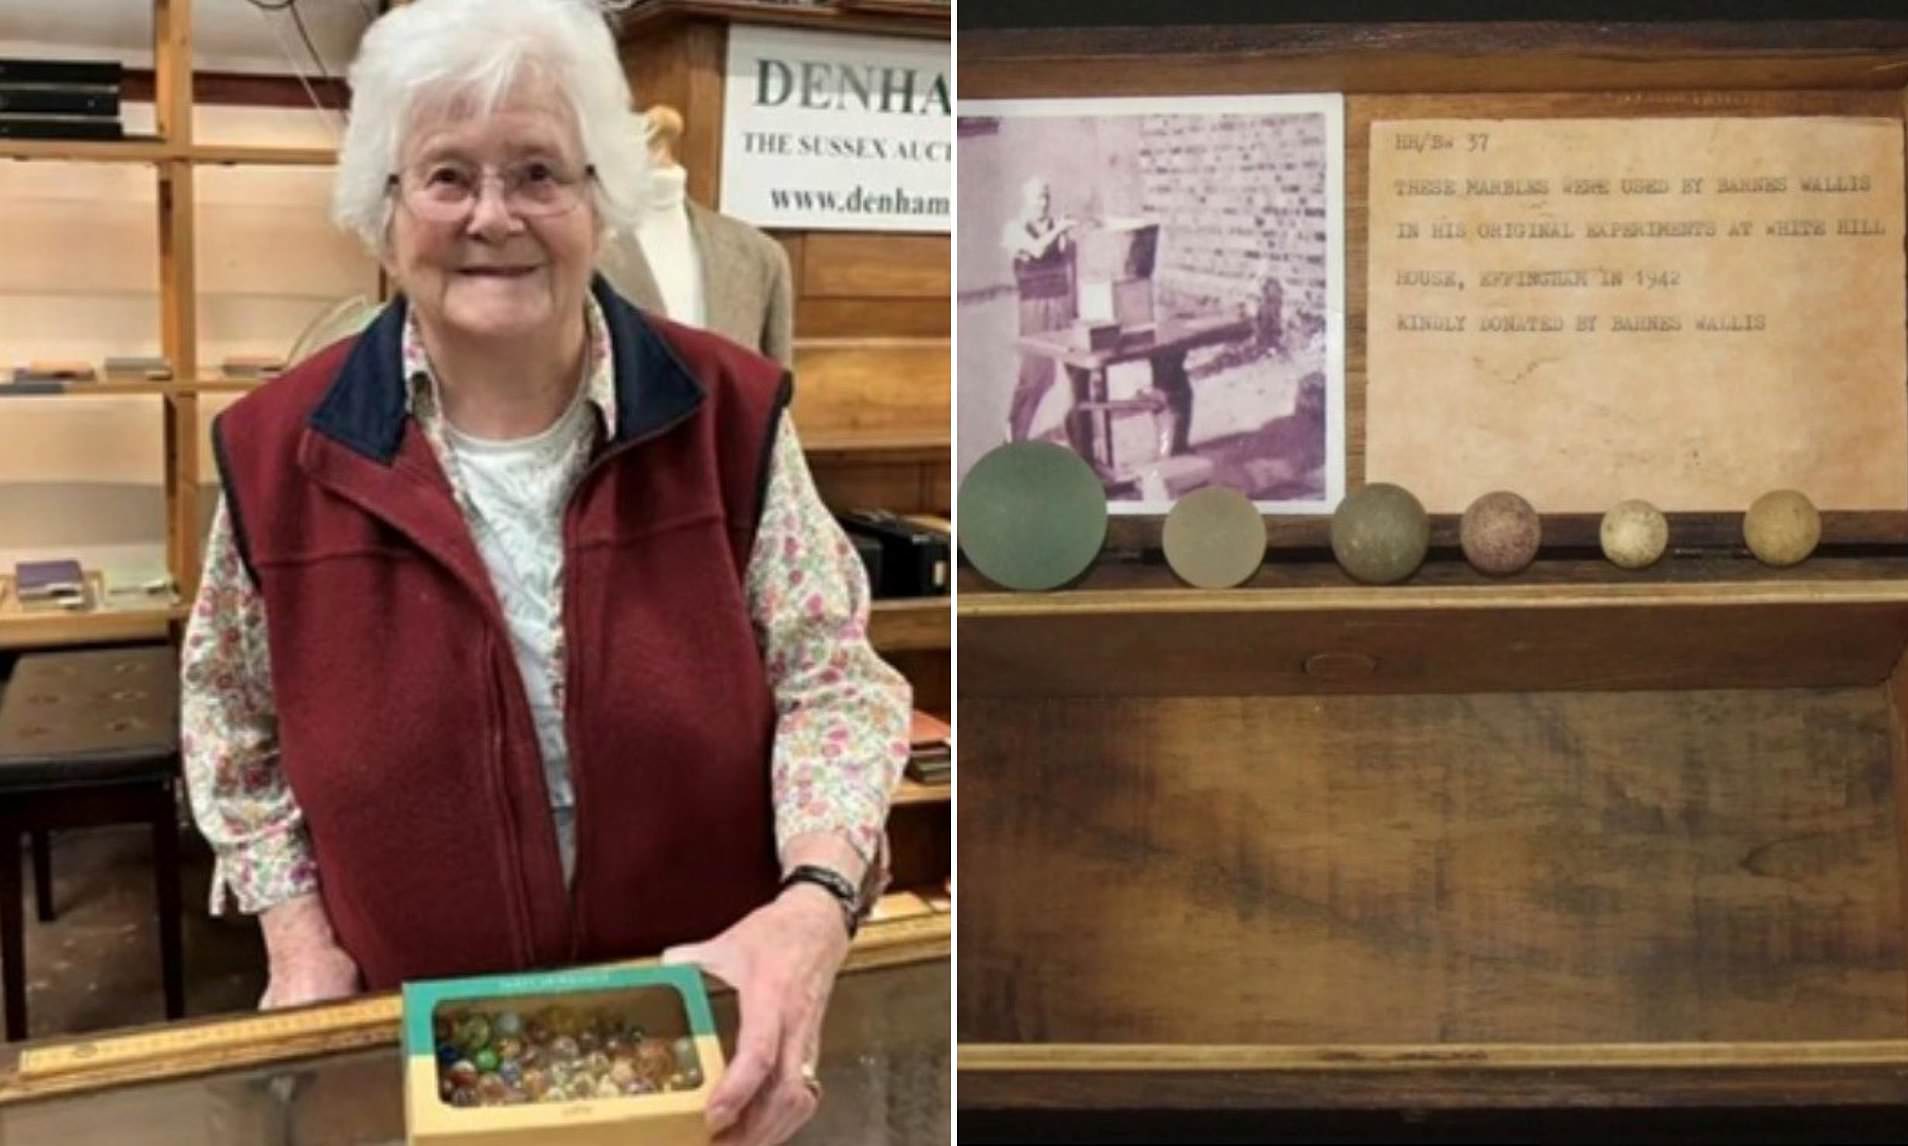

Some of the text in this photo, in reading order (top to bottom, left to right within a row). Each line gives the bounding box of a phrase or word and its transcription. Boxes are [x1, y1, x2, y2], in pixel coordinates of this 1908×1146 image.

[743, 131, 792, 155] THE
[798, 135, 887, 159] SUSSEX
[1467, 132, 1489, 152] 37
[1394, 174, 1872, 196] THESE MARBLES WERE USED BY BARNES WALLIS
[770, 184, 950, 215] www.denham
[1396, 217, 1887, 239] IN HIS ORIGINAL EXPERIMENTS AT WHITE HILL
[1395, 269, 1681, 291] HOUSE, EFFINGHAM IN 1942
[1397, 313, 1767, 332] KINDLY DONATED BY BARNES WALLIS
